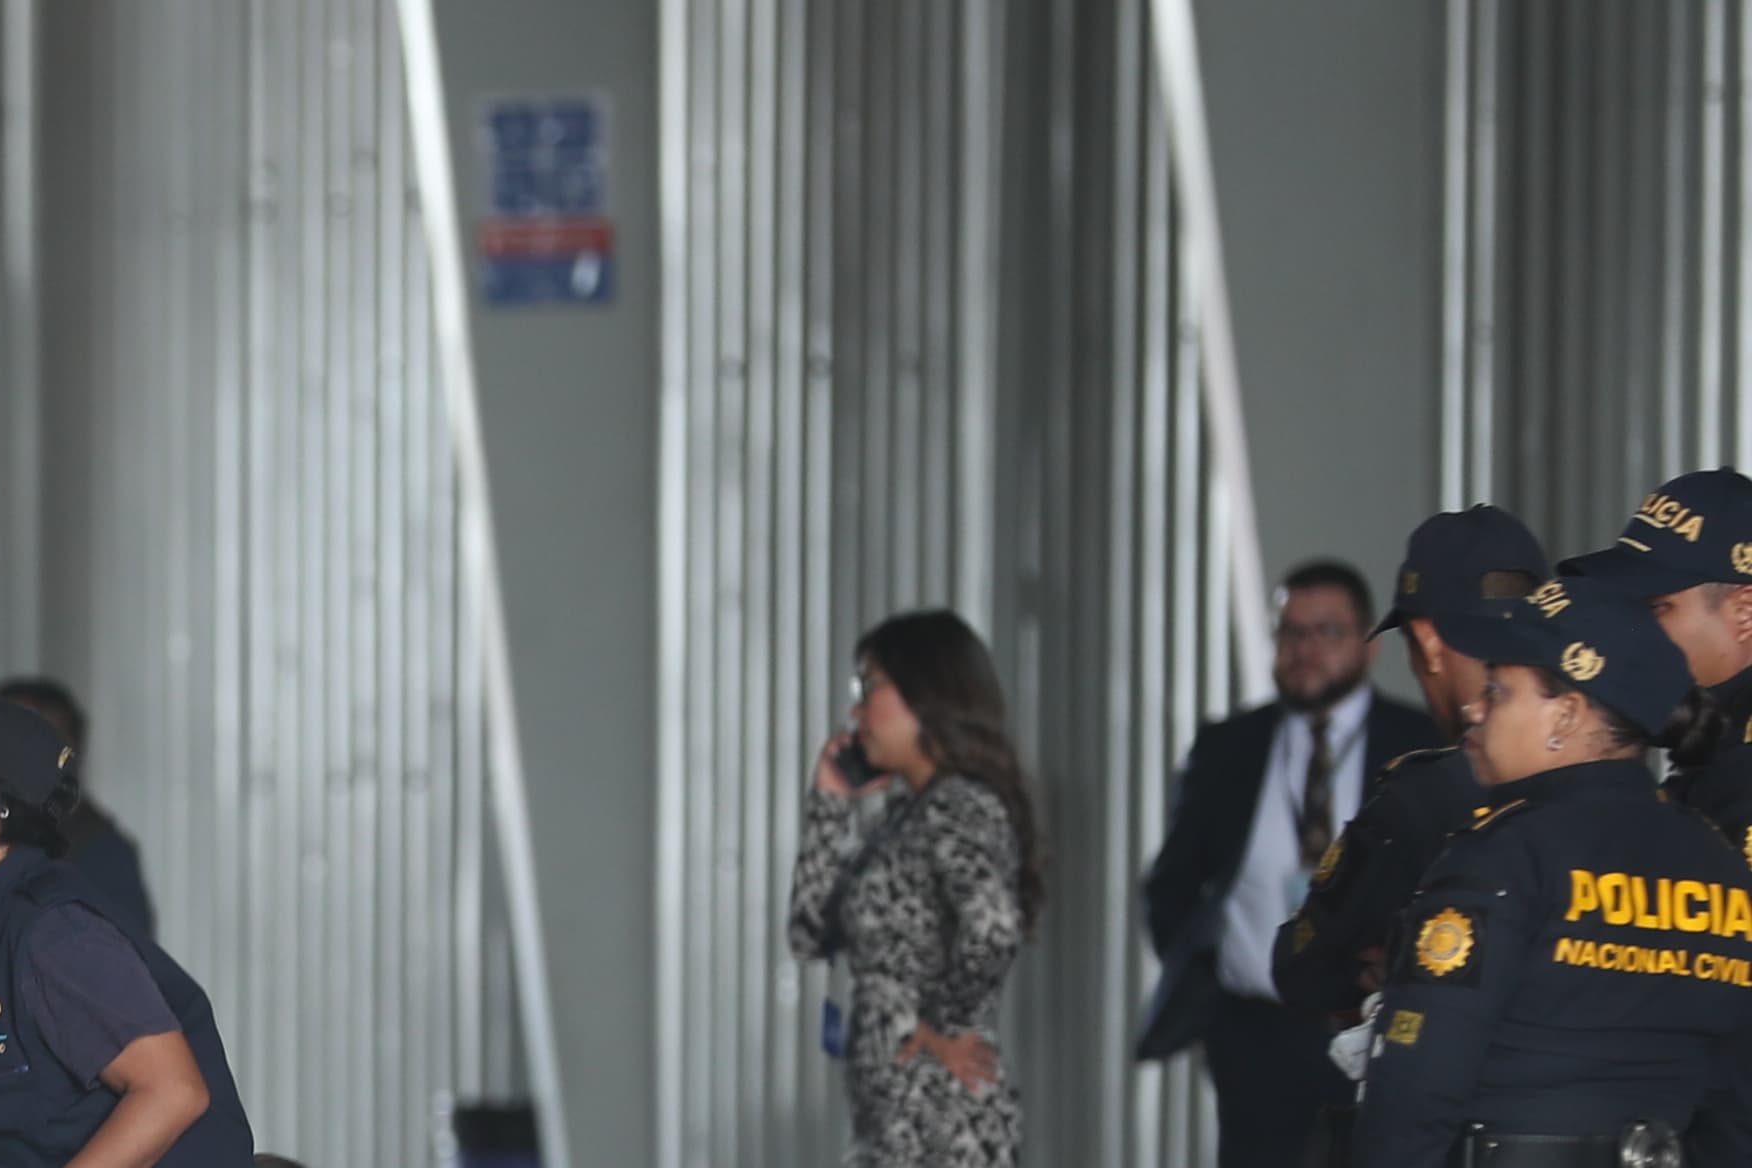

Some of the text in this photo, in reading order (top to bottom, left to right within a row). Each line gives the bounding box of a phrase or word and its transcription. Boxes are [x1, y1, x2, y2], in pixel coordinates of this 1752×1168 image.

[1564, 868, 1752, 942] POLICIA
[1553, 937, 1752, 987] NACIONAL CIVIL
